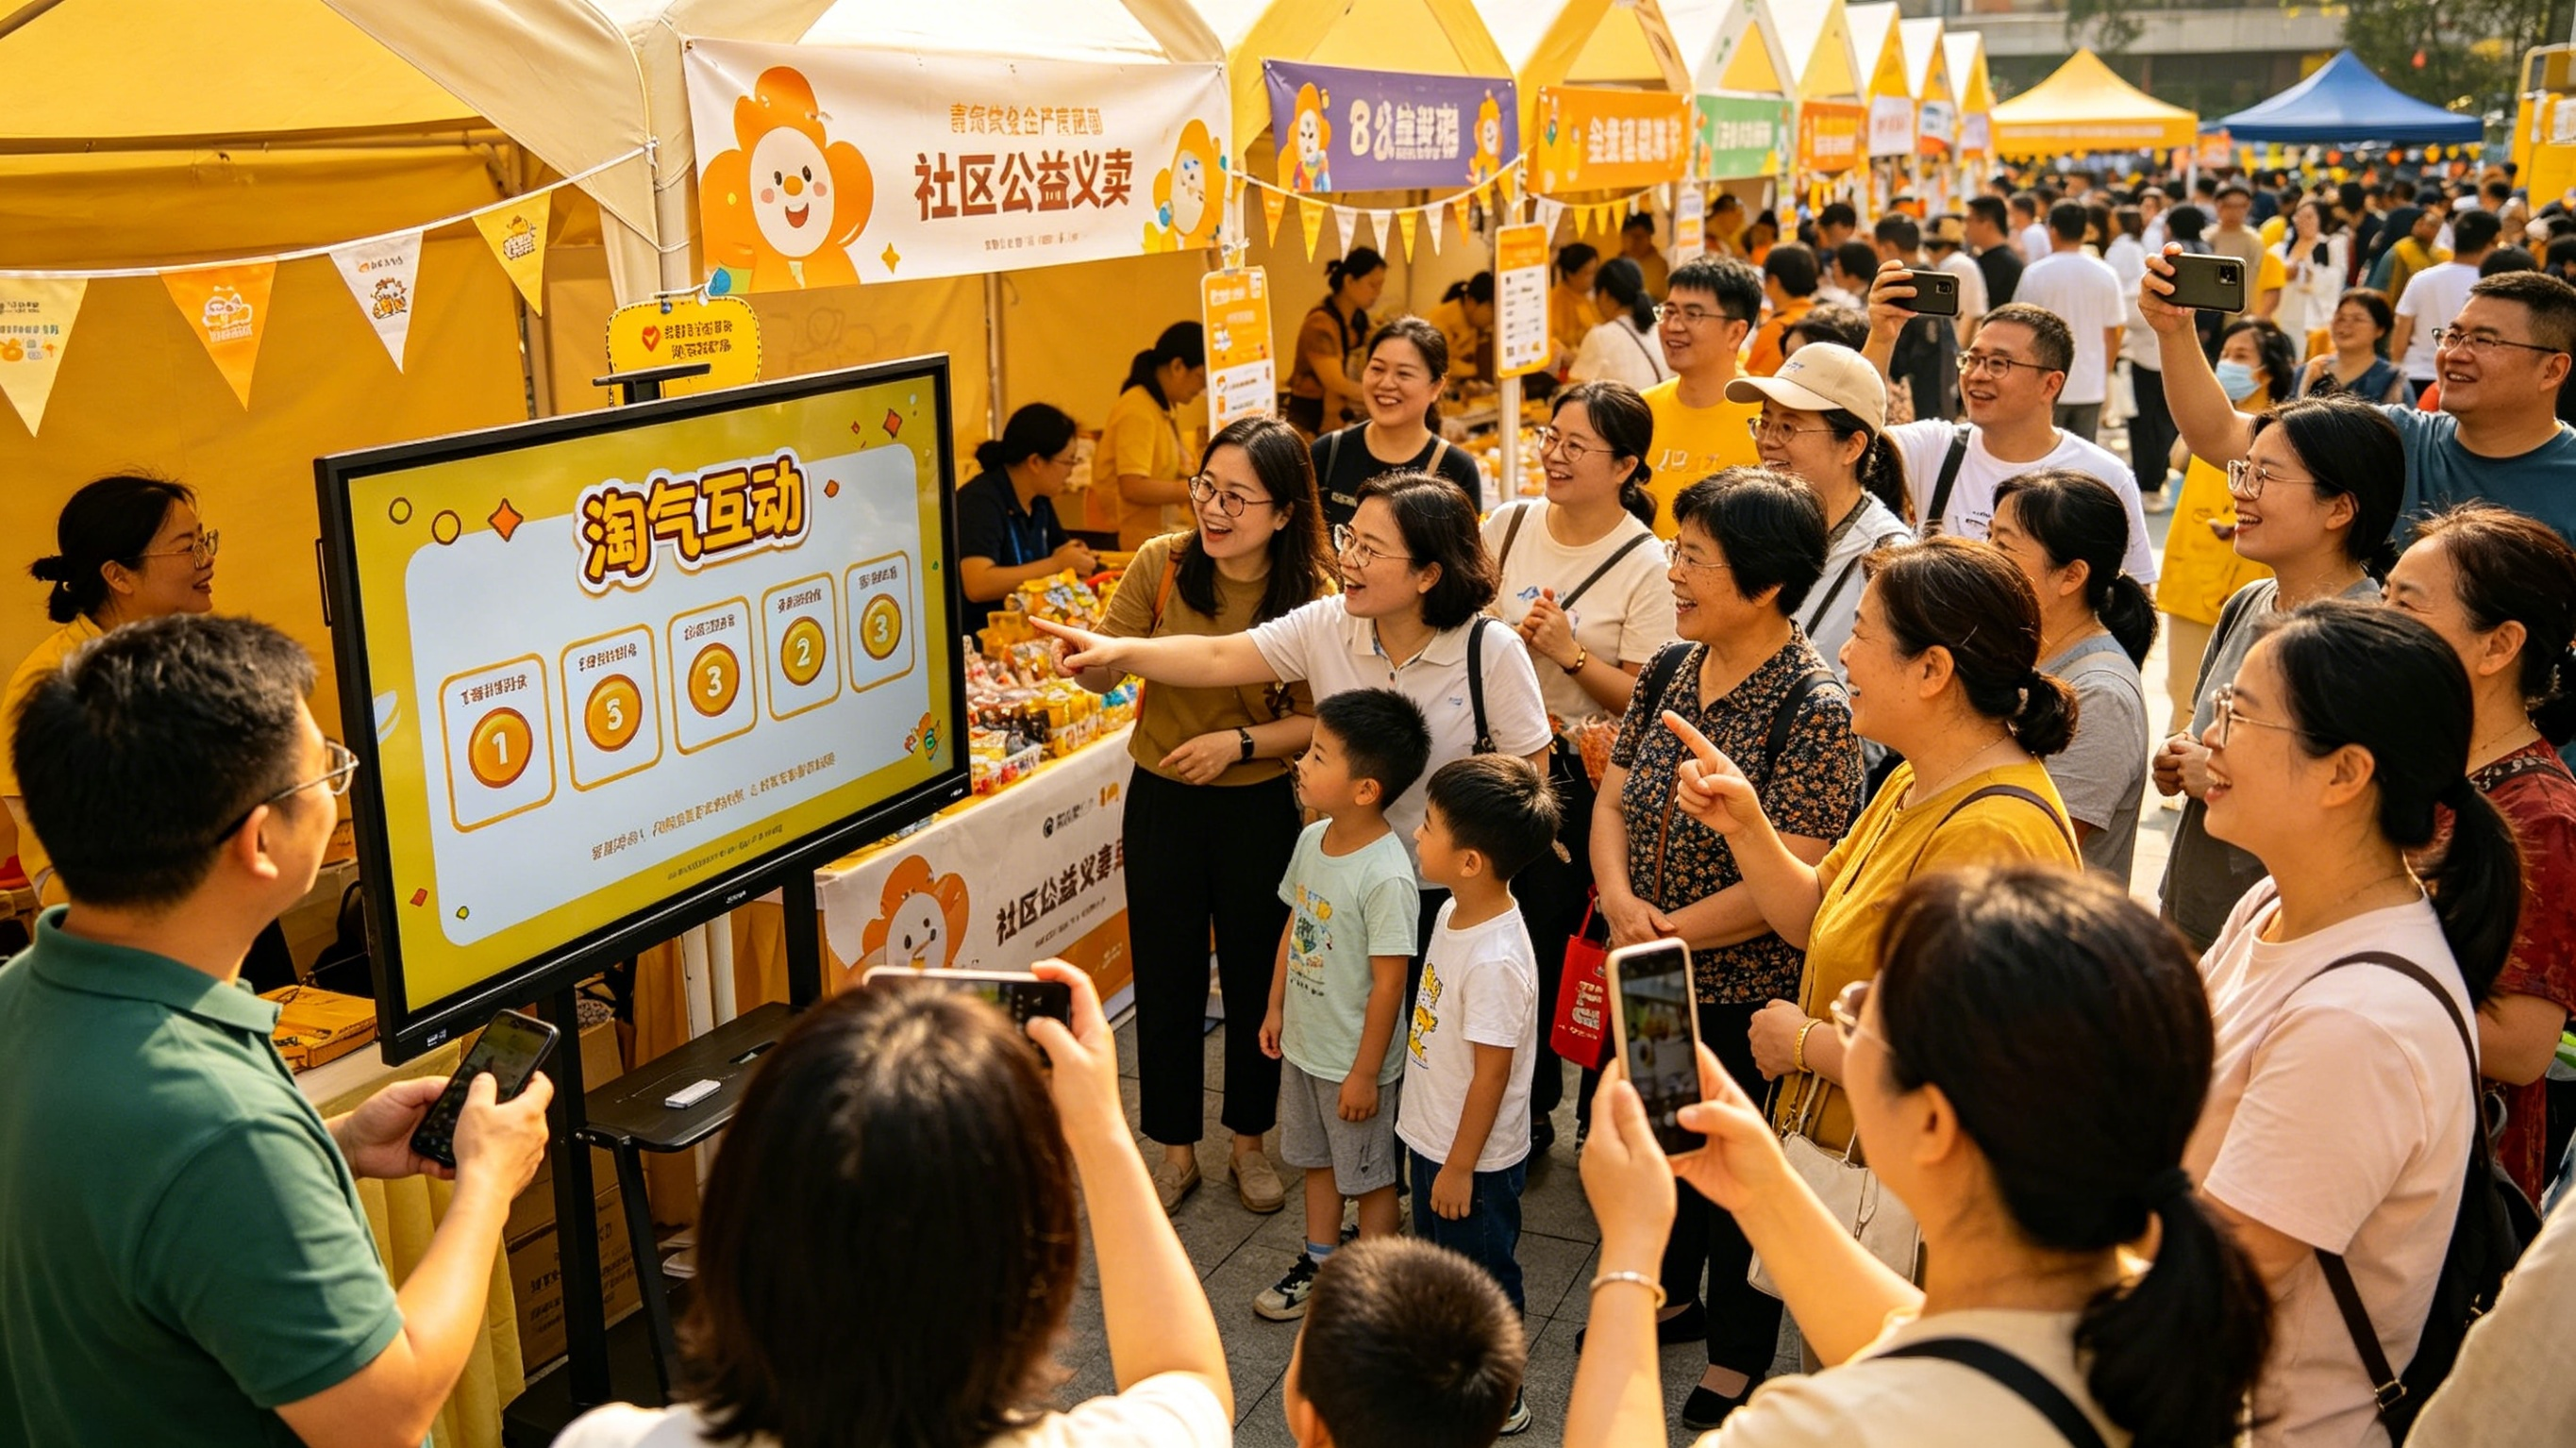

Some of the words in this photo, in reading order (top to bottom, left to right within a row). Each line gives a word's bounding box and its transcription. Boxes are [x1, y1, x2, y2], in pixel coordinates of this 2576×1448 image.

[914, 148, 1132, 222] 社区公益义卖
[582, 455, 805, 584] 淘气互动
[874, 614, 889, 643] 3
[796, 637, 811, 667] 2
[706, 665, 723, 697] 3
[492, 731, 509, 765] 1
